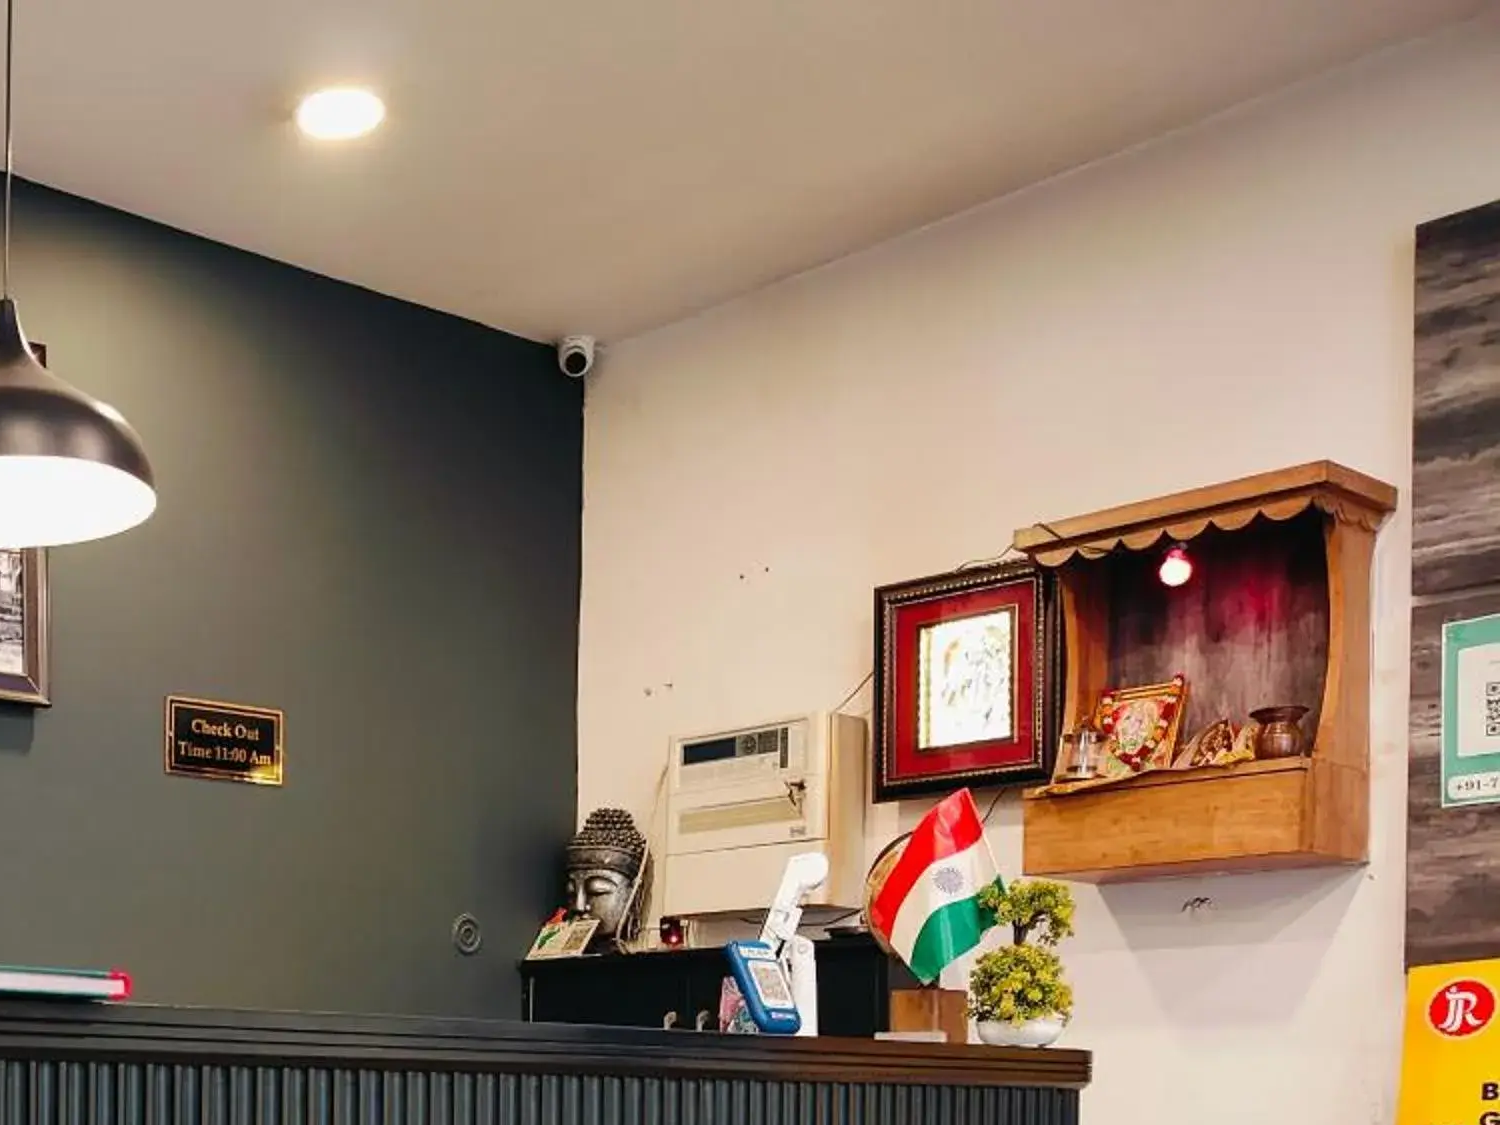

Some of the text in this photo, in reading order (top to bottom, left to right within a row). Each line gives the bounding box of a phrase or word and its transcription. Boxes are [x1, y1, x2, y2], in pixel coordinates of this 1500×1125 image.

[191, 718, 260, 741] Check Out
[178, 740, 213, 760] Time
[249, 749, 271, 765] Am
